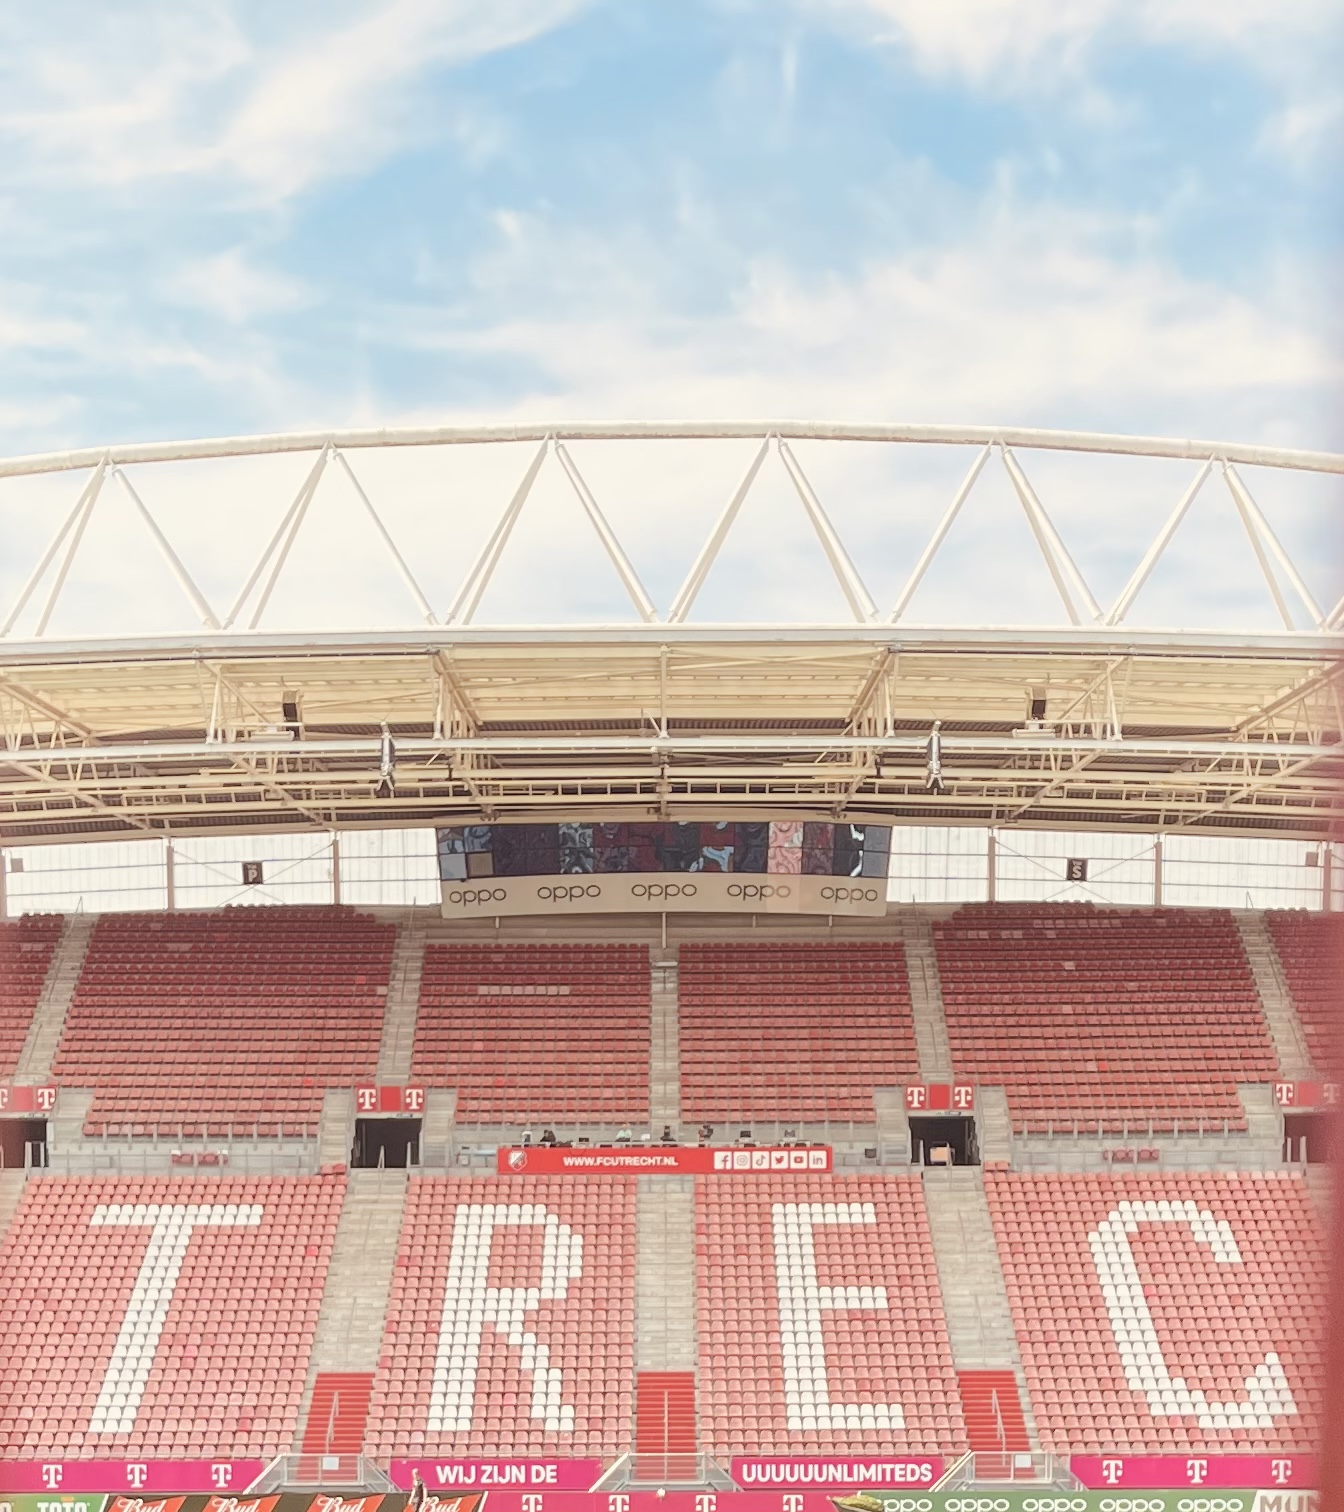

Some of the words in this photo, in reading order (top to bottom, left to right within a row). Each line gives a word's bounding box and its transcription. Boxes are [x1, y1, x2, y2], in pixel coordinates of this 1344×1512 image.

[449, 885, 507, 907] oppo
[537, 884, 601, 903] oppo
[631, 882, 698, 901] oppo
[727, 882, 791, 901] oppo
[820, 884, 879, 903] oppo
[563, 1156, 679, 1167] WWW.FCUTRECHT.NL
[436, 1465, 476, 1483] WIJ
[480, 1465, 526, 1483] ZIJN
[531, 1465, 557, 1483] DE
